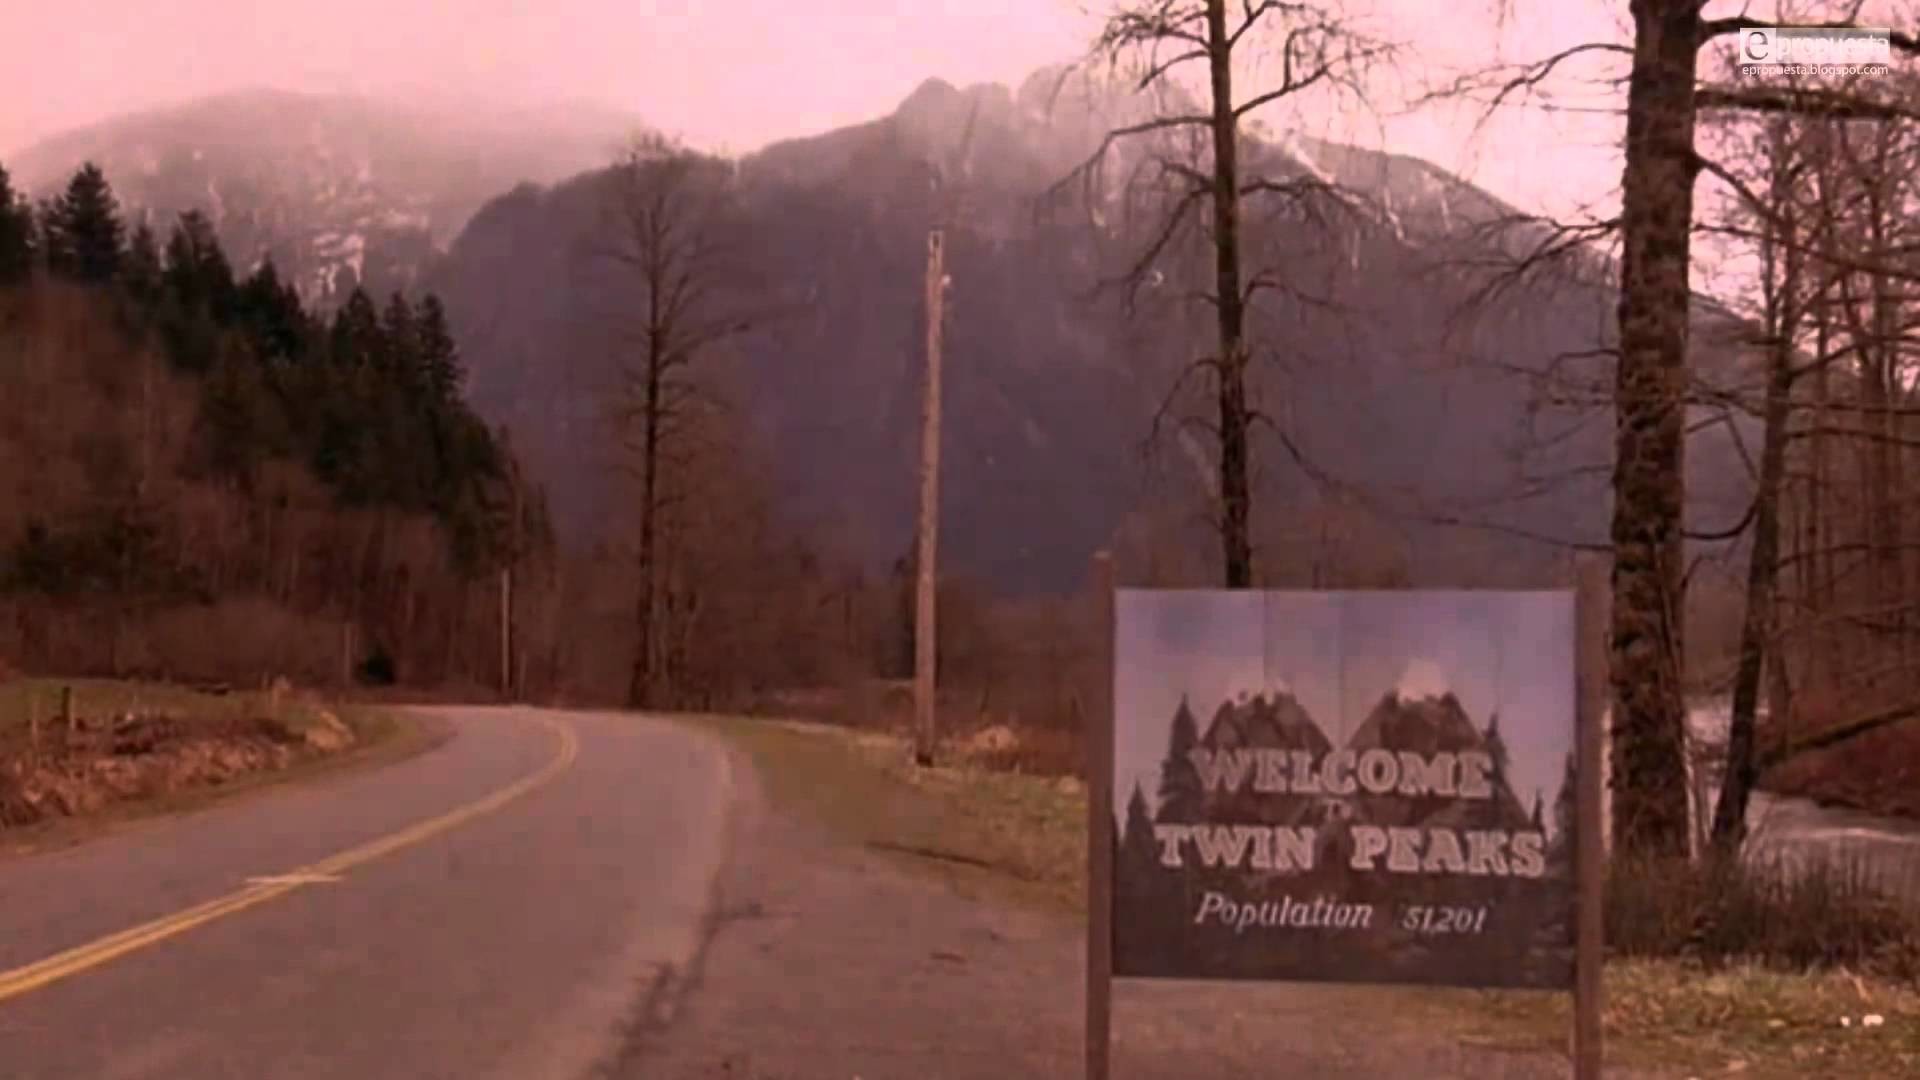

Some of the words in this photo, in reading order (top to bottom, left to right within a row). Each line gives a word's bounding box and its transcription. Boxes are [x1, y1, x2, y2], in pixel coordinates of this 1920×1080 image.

[1188, 747, 1493, 797] WELCOME
[1154, 823, 1317, 871] TWIN
[1348, 827, 1547, 878] PEAKS
[1195, 892, 1373, 934] Population
